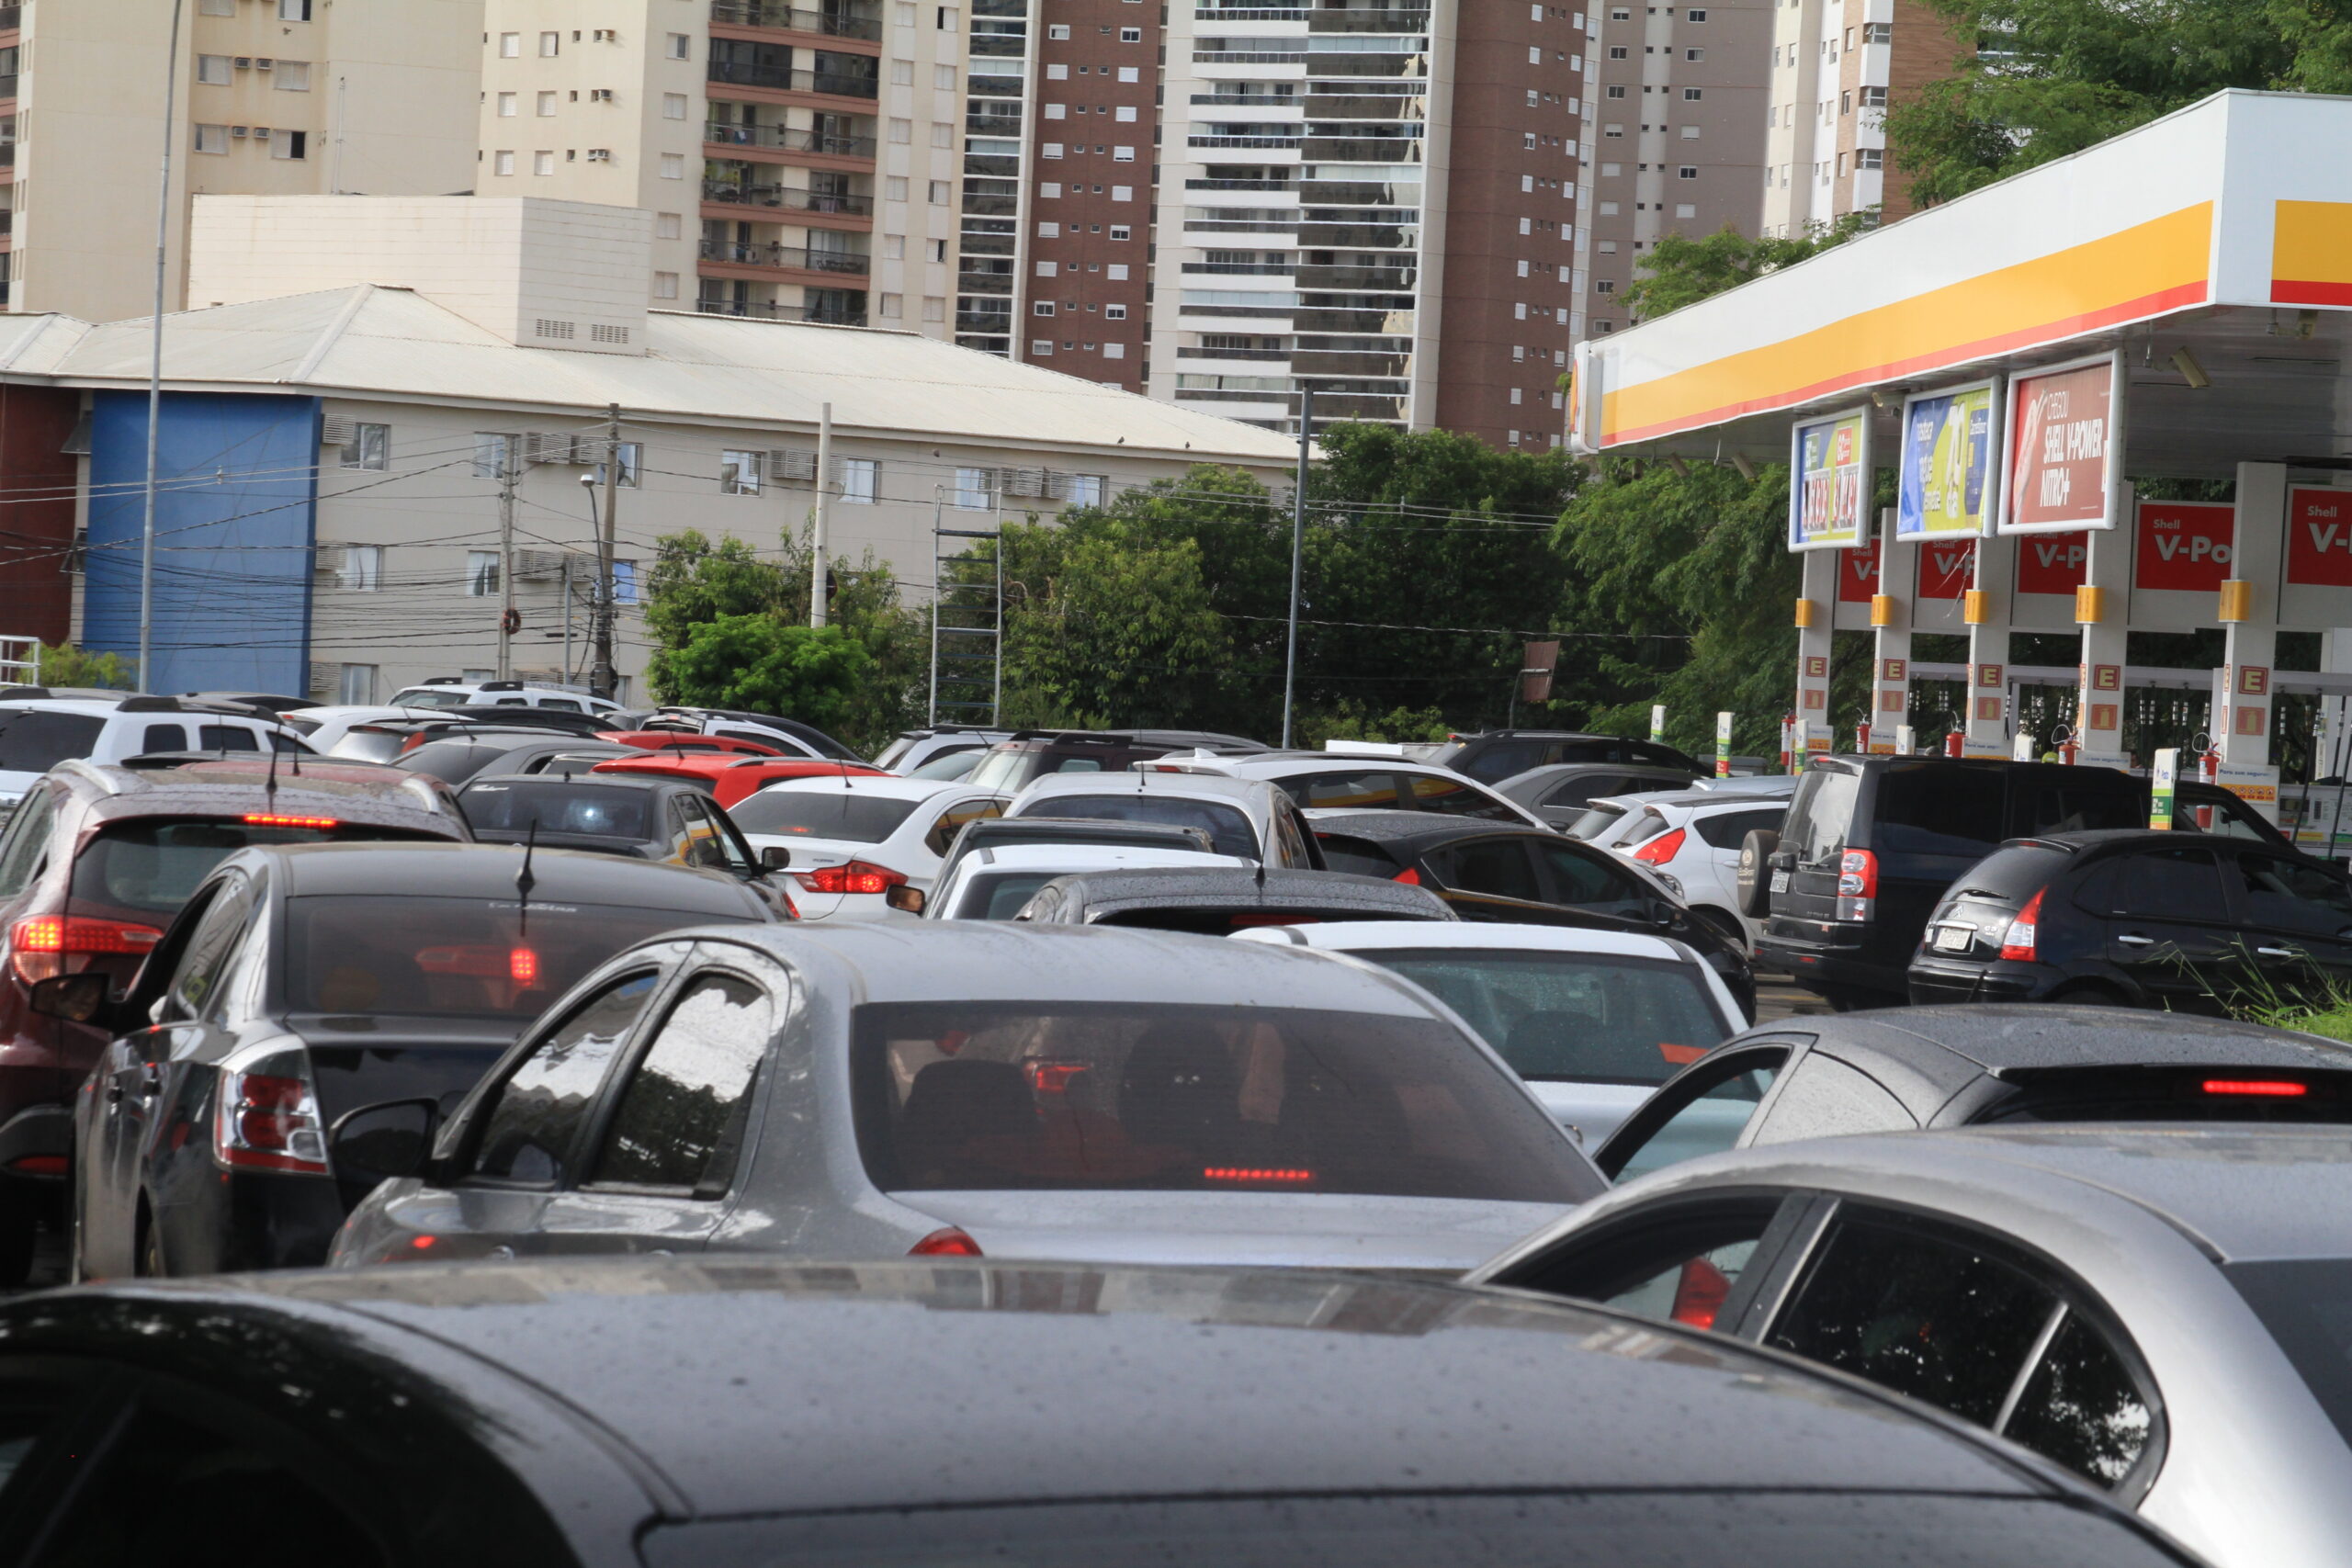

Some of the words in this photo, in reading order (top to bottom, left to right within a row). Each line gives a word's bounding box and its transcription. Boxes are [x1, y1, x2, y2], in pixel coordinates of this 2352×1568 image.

[2047, 390, 2069, 421] CHEGOU
[2043, 423, 2065, 464] SHELL
[2066, 418, 2103, 461] V-POWER
[2040, 467, 2070, 507] NITRO+
[2307, 505, 2338, 518] Shell
[2153, 519, 2180, 531] Shell
[1932, 538, 1956, 549] Shell
[2308, 523, 2352, 555] V-
[1852, 547, 1873, 558] Shell
[1810, 660, 1822, 674] E
[1888, 662, 1902, 678] E
[1983, 668, 1997, 684] E
[2099, 670, 2115, 687] E
[2245, 672, 2262, 691] E
